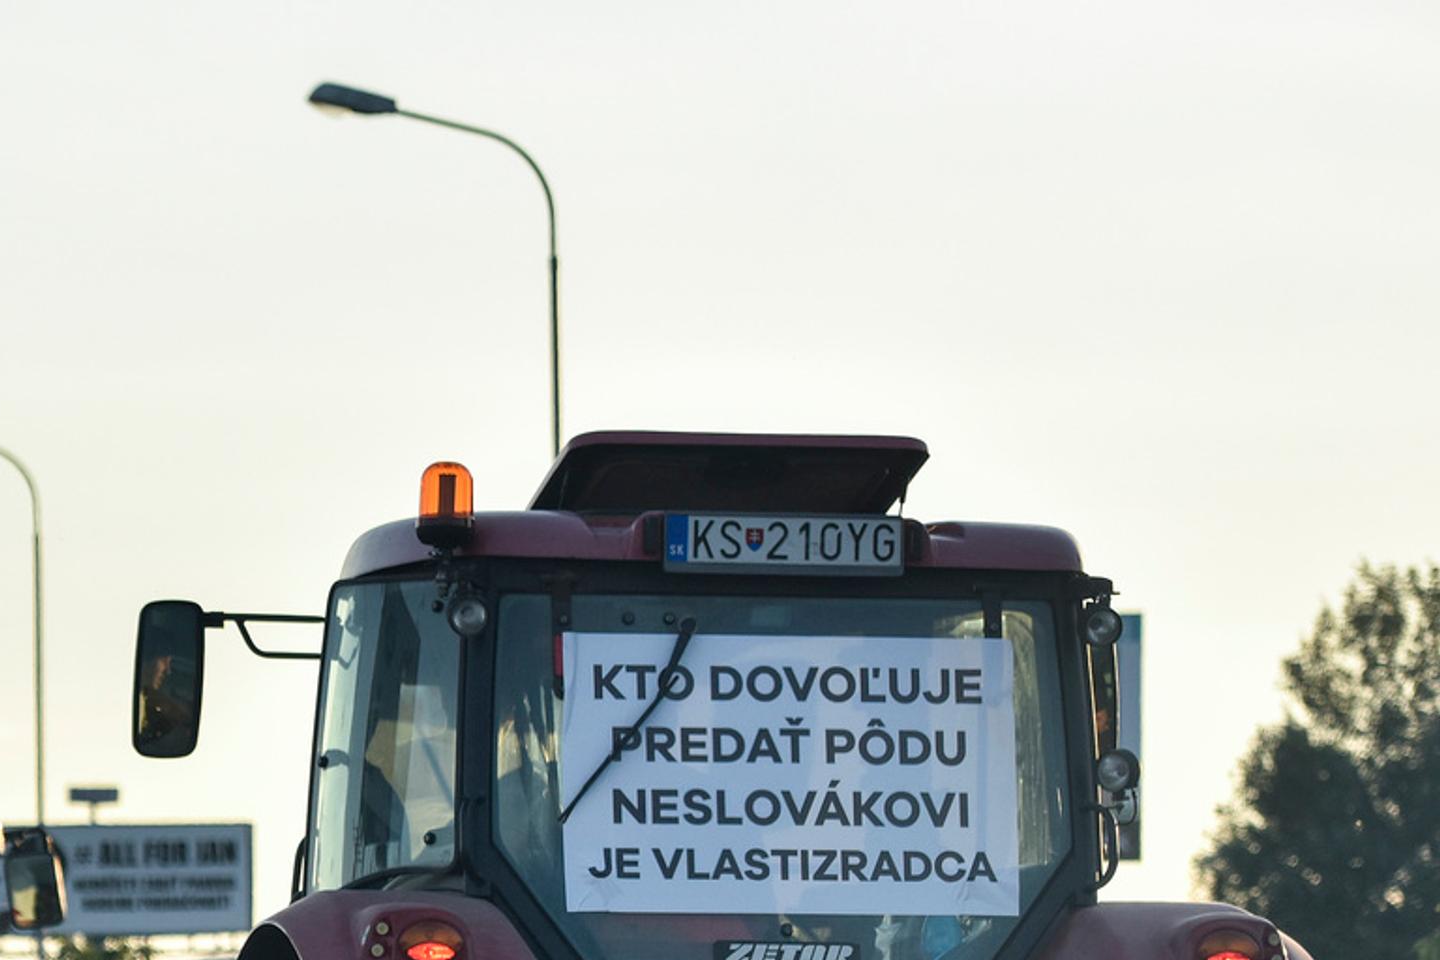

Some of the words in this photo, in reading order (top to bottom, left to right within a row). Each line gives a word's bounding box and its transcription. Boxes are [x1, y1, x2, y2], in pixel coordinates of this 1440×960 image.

[669, 544, 685, 556] SK
[592, 664, 695, 701] KTO
[709, 665, 983, 704] DOVOĽUJE
[611, 717, 811, 764] PREDAŤ
[825, 718, 967, 766] PÔDU
[612, 780, 970, 828] NESLOVÁKOVI
[588, 848, 641, 880] JE
[652, 848, 999, 883] VLASTIZRADCA
